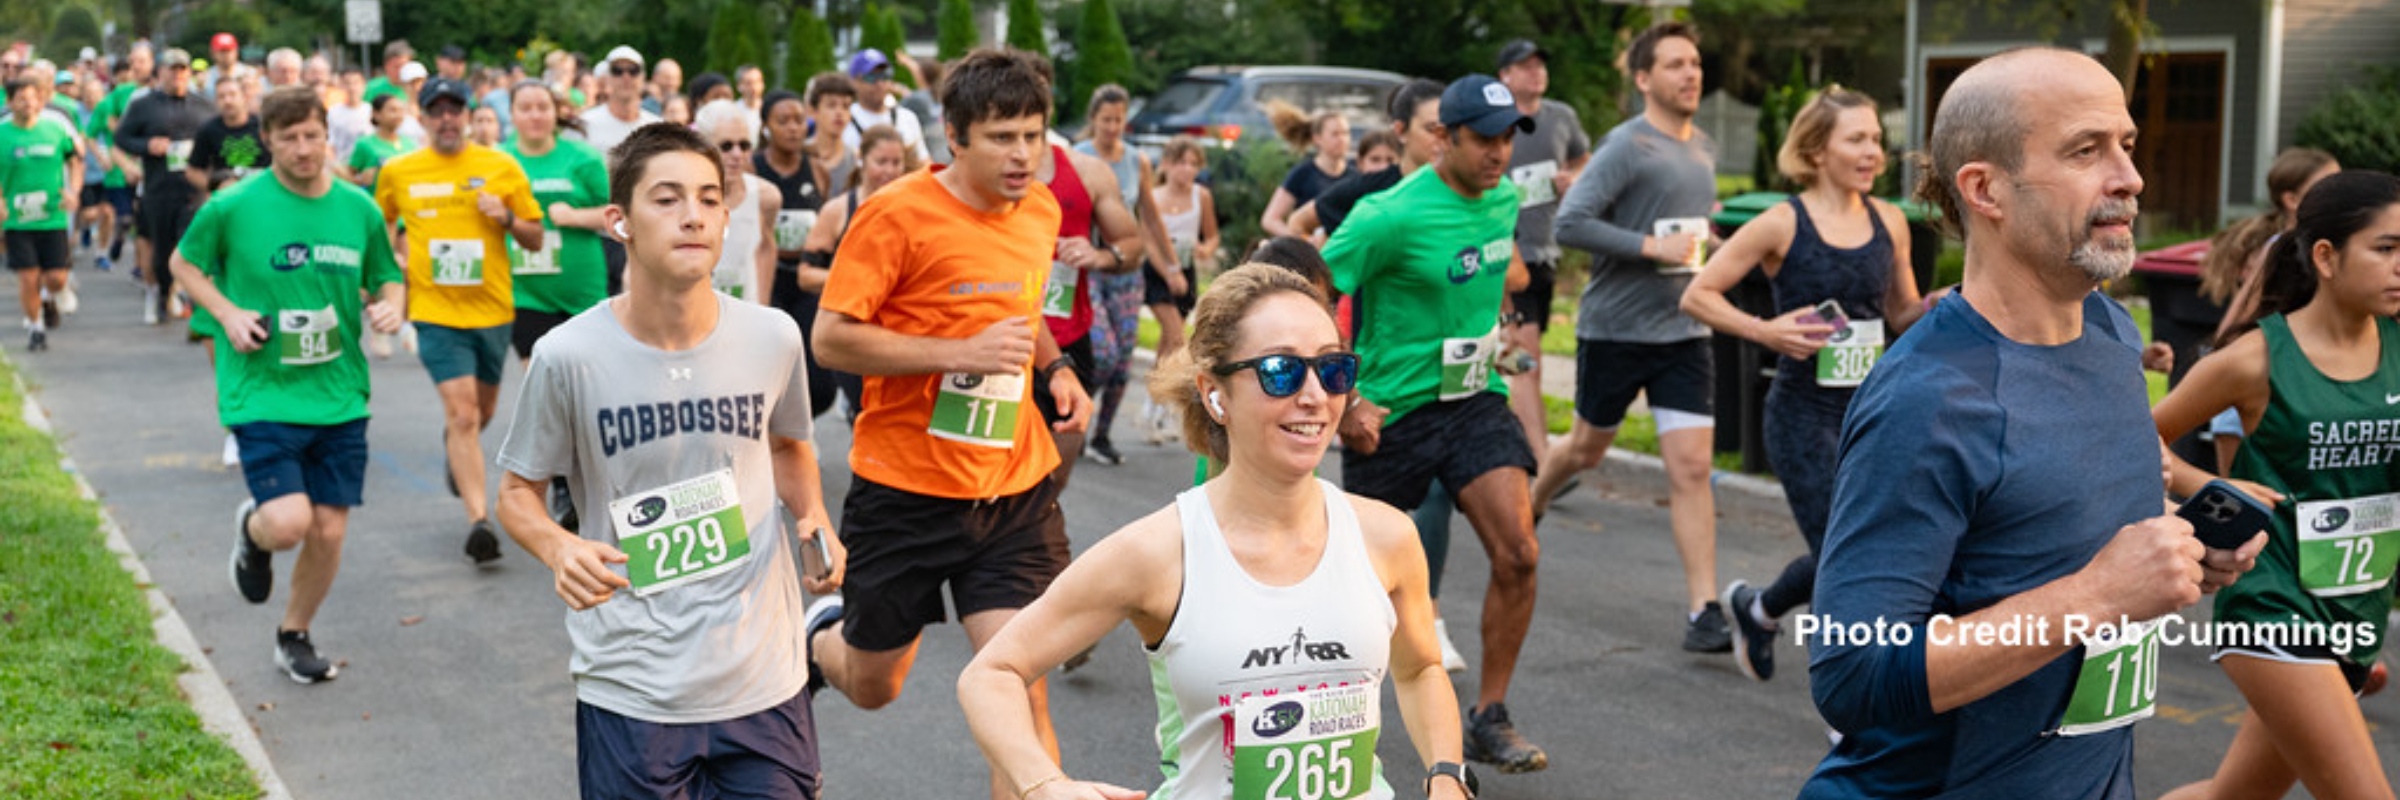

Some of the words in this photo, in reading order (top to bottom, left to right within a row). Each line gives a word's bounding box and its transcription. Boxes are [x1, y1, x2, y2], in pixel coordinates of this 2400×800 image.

[301, 331, 328, 358] 94
[1832, 348, 1876, 379] 303
[597, 393, 765, 458] COBBOSSEE
[966, 399, 998, 438] 11
[2307, 443, 2400, 470] HEART
[646, 517, 728, 579] 229
[2334, 536, 2375, 585] 72
[2104, 633, 2159, 717] 110
[1309, 693, 1367, 721] KATONAH
[1309, 718, 1337, 736] ROAD
[1338, 713, 1367, 732] RACES
[1265, 739, 1353, 800] 265
